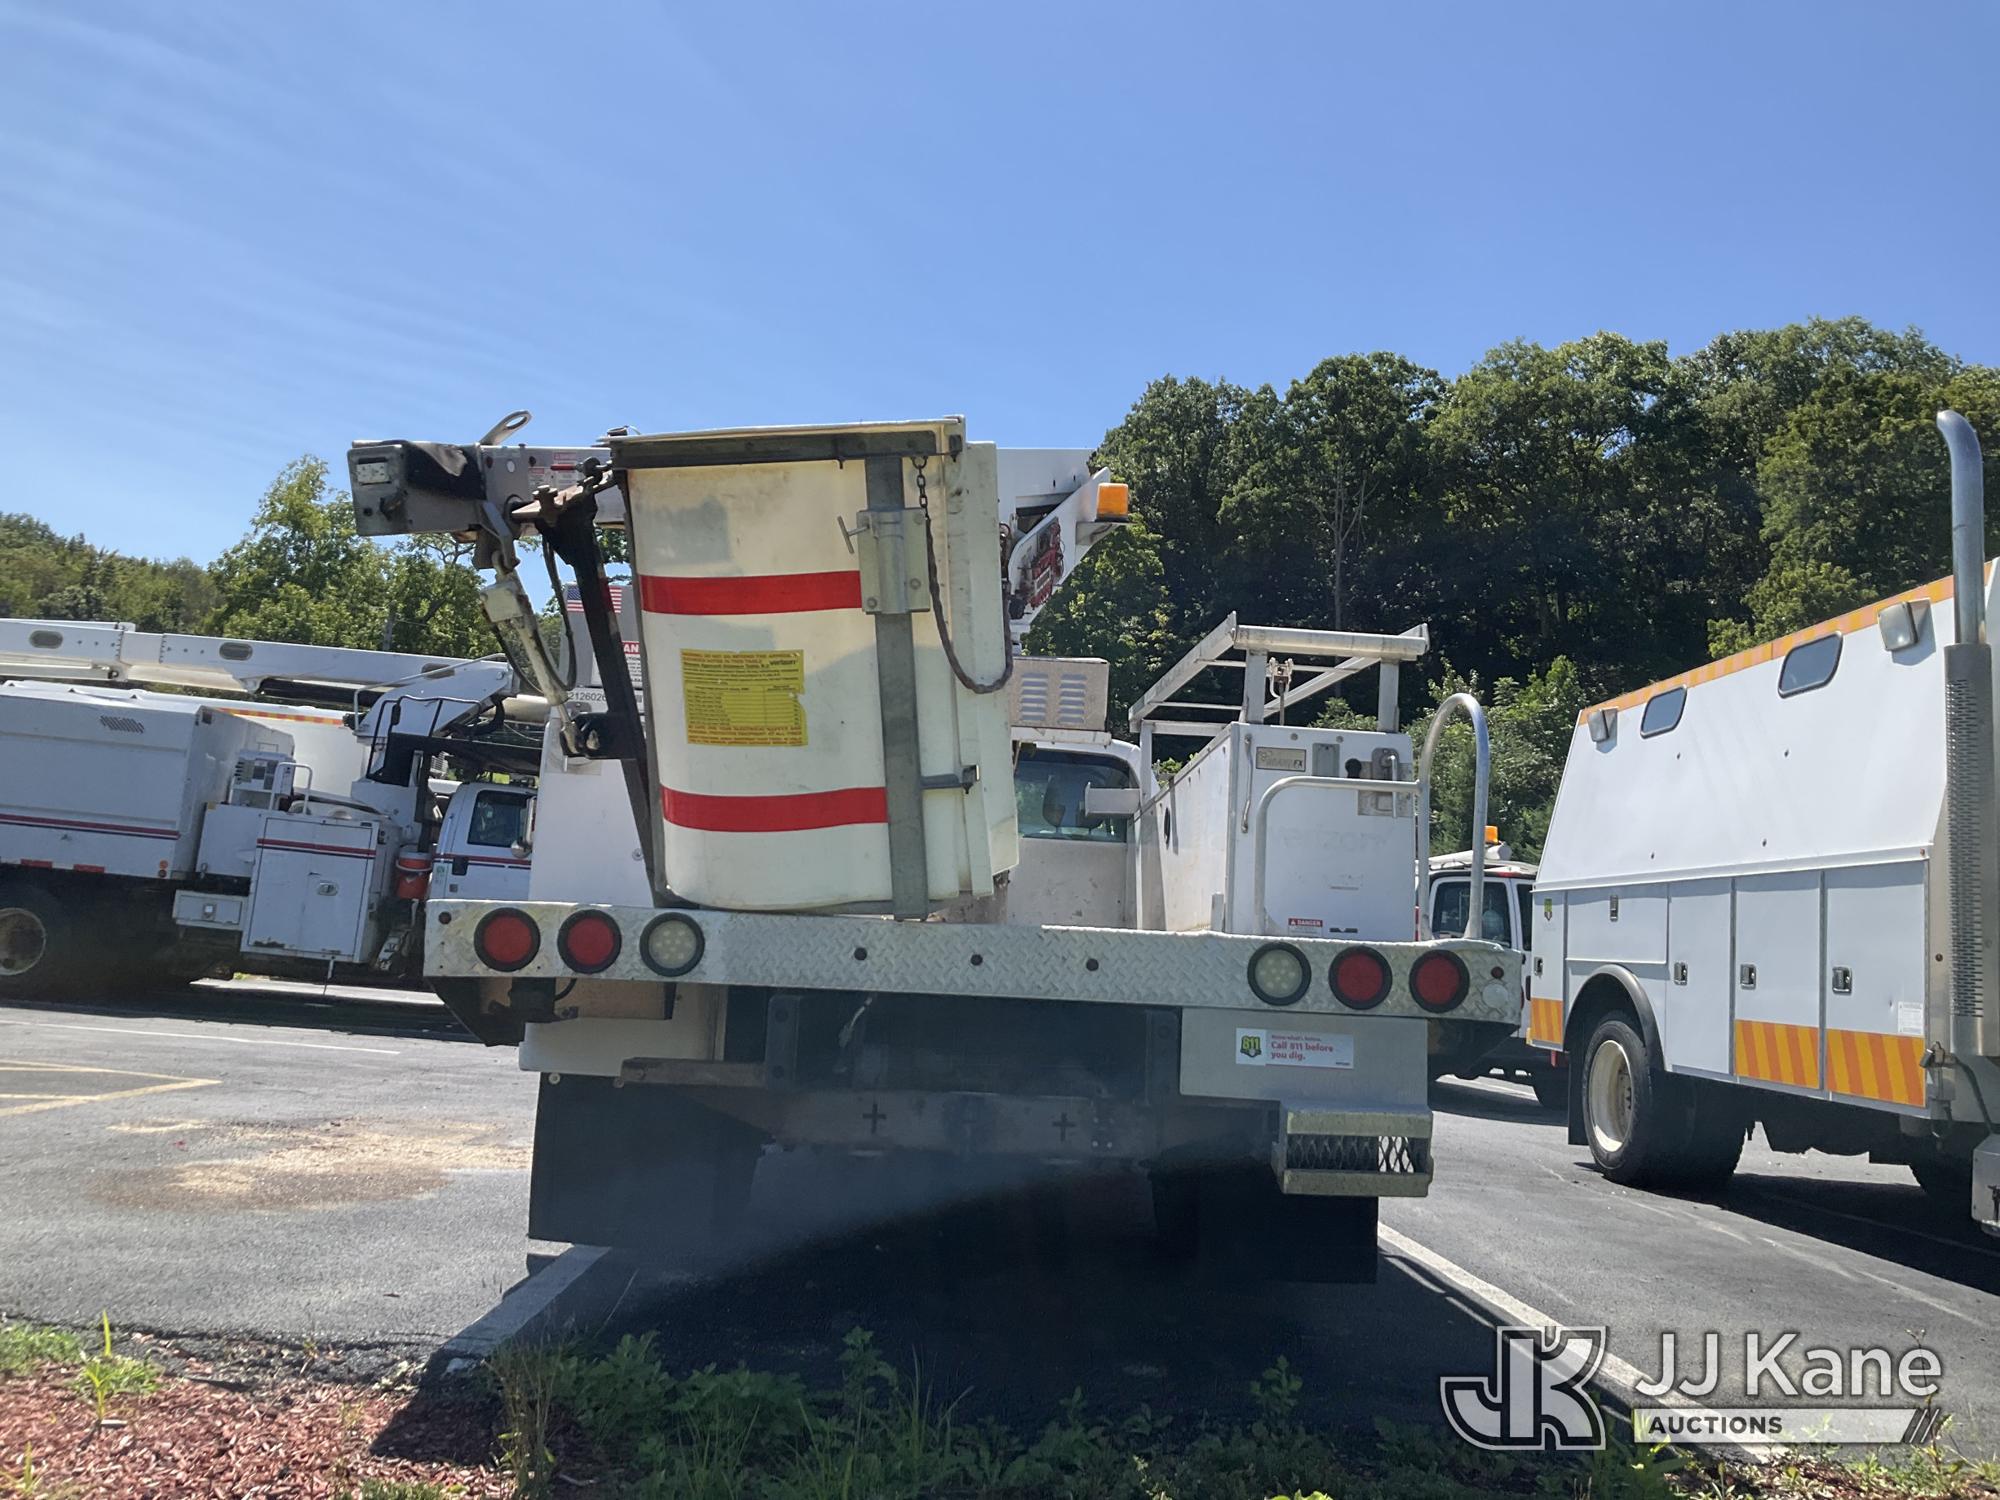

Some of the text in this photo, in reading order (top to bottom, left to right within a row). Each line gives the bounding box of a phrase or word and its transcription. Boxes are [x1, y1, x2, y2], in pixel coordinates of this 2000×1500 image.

[1271, 1041, 1287, 1049] Call
[1305, 1042, 1334, 1052] before
[1271, 1051, 1306, 1061] you dig.
